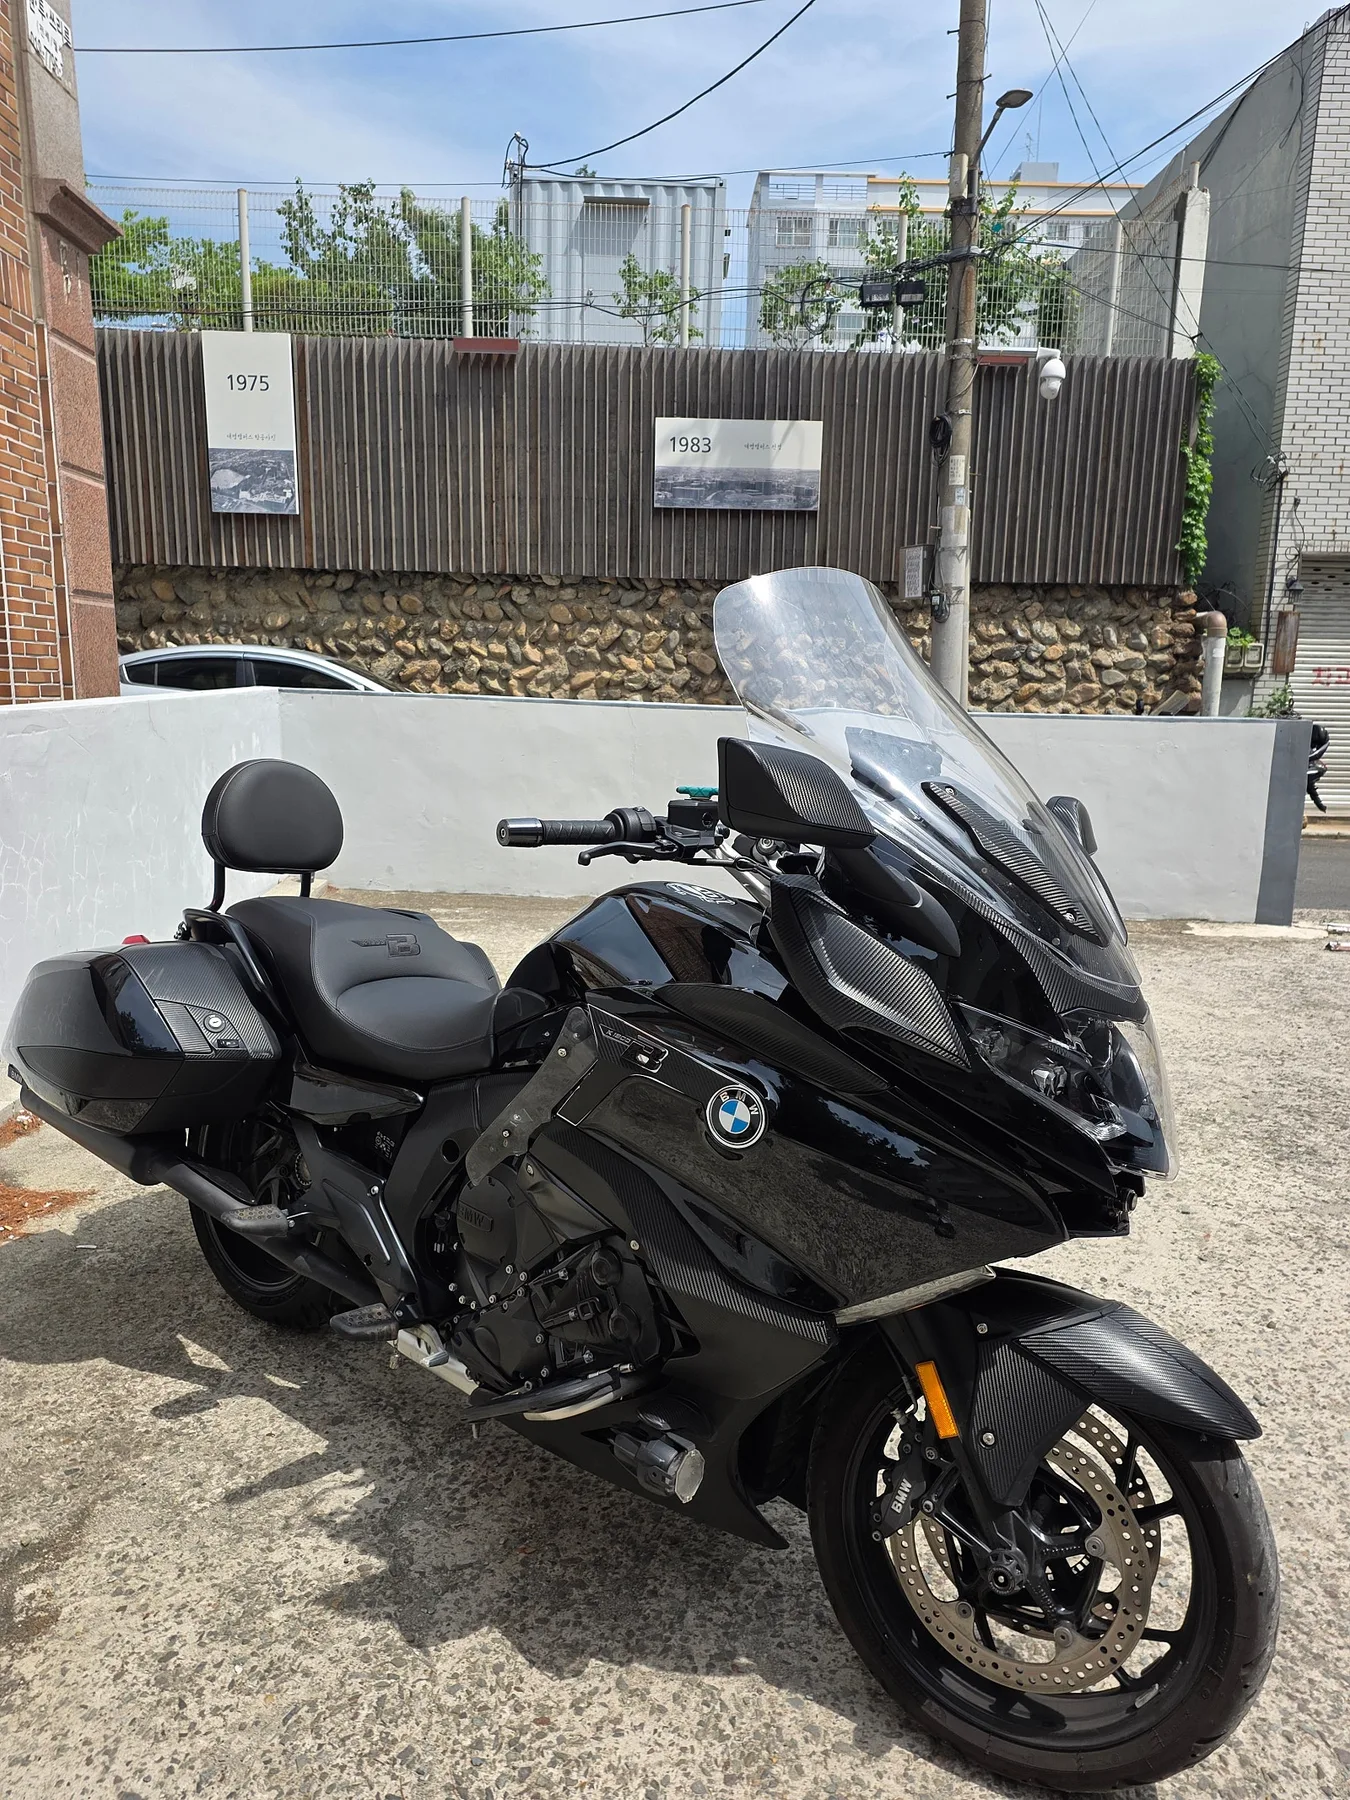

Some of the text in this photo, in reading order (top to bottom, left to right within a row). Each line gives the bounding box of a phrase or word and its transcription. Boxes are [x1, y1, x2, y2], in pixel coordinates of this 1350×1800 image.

[226, 374, 270, 392] 1975
[669, 436, 712, 453] 1983
[719, 1090, 760, 1115] BMW
[459, 1205, 486, 1228] BMW
[891, 1478, 912, 1514] BMW
